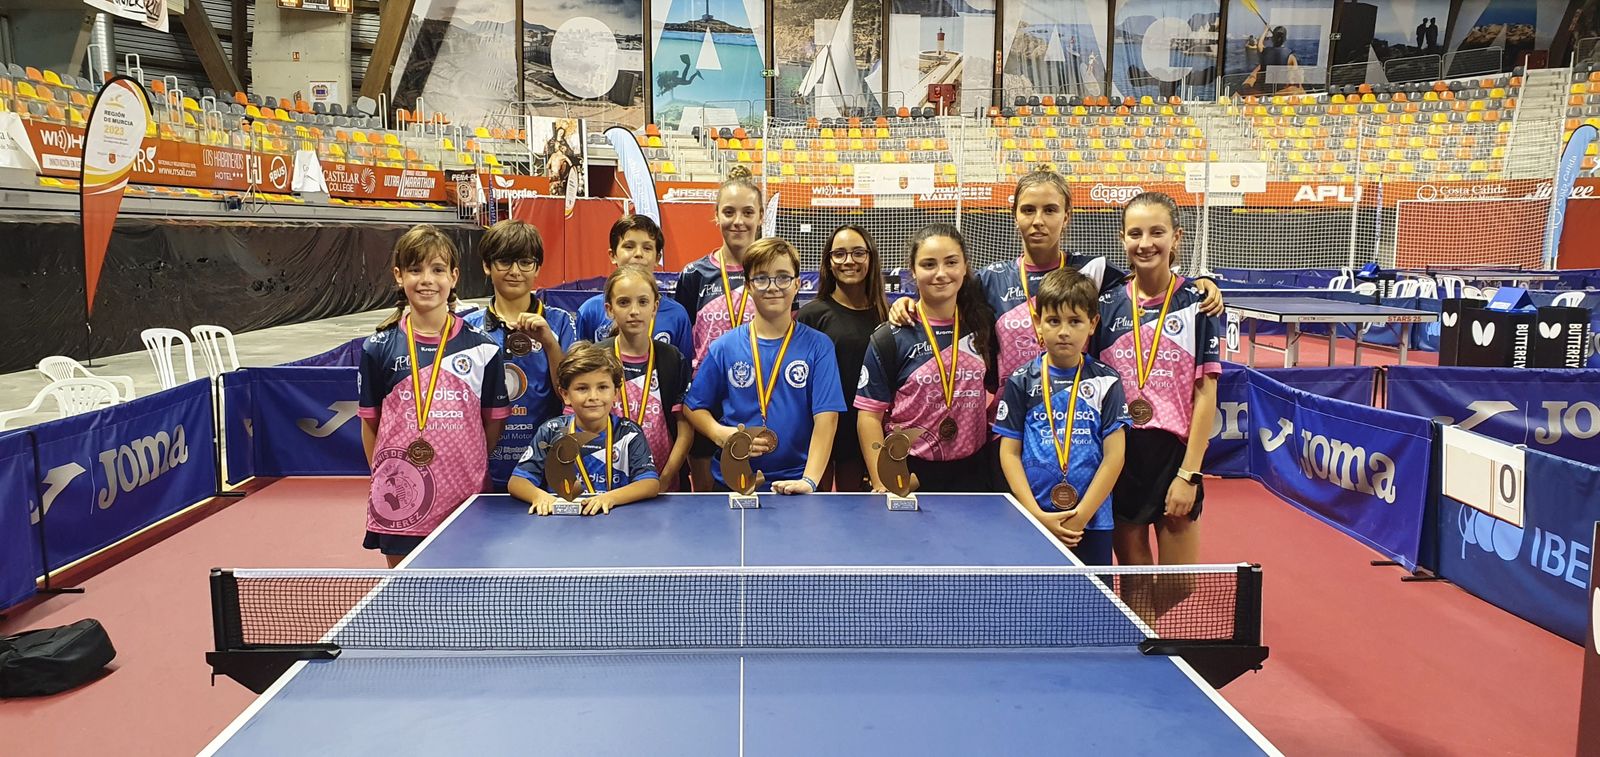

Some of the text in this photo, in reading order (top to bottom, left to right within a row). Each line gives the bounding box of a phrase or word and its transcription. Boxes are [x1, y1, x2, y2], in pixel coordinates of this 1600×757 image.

[104, 110, 125, 118] REGIÓN
[112, 117, 134, 126] MURCIA
[104, 125, 125, 136] 2023
[323, 170, 359, 184] CASTELAR
[328, 182, 355, 193] COLLEGE
[1093, 185, 1141, 202] dqagro
[1513, 324, 1529, 368] BUTTERFLY
[1566, 323, 1583, 368] BUTTERFLY
[1499, 464, 1516, 503] 0
[390, 512, 422, 528] JEREZ
